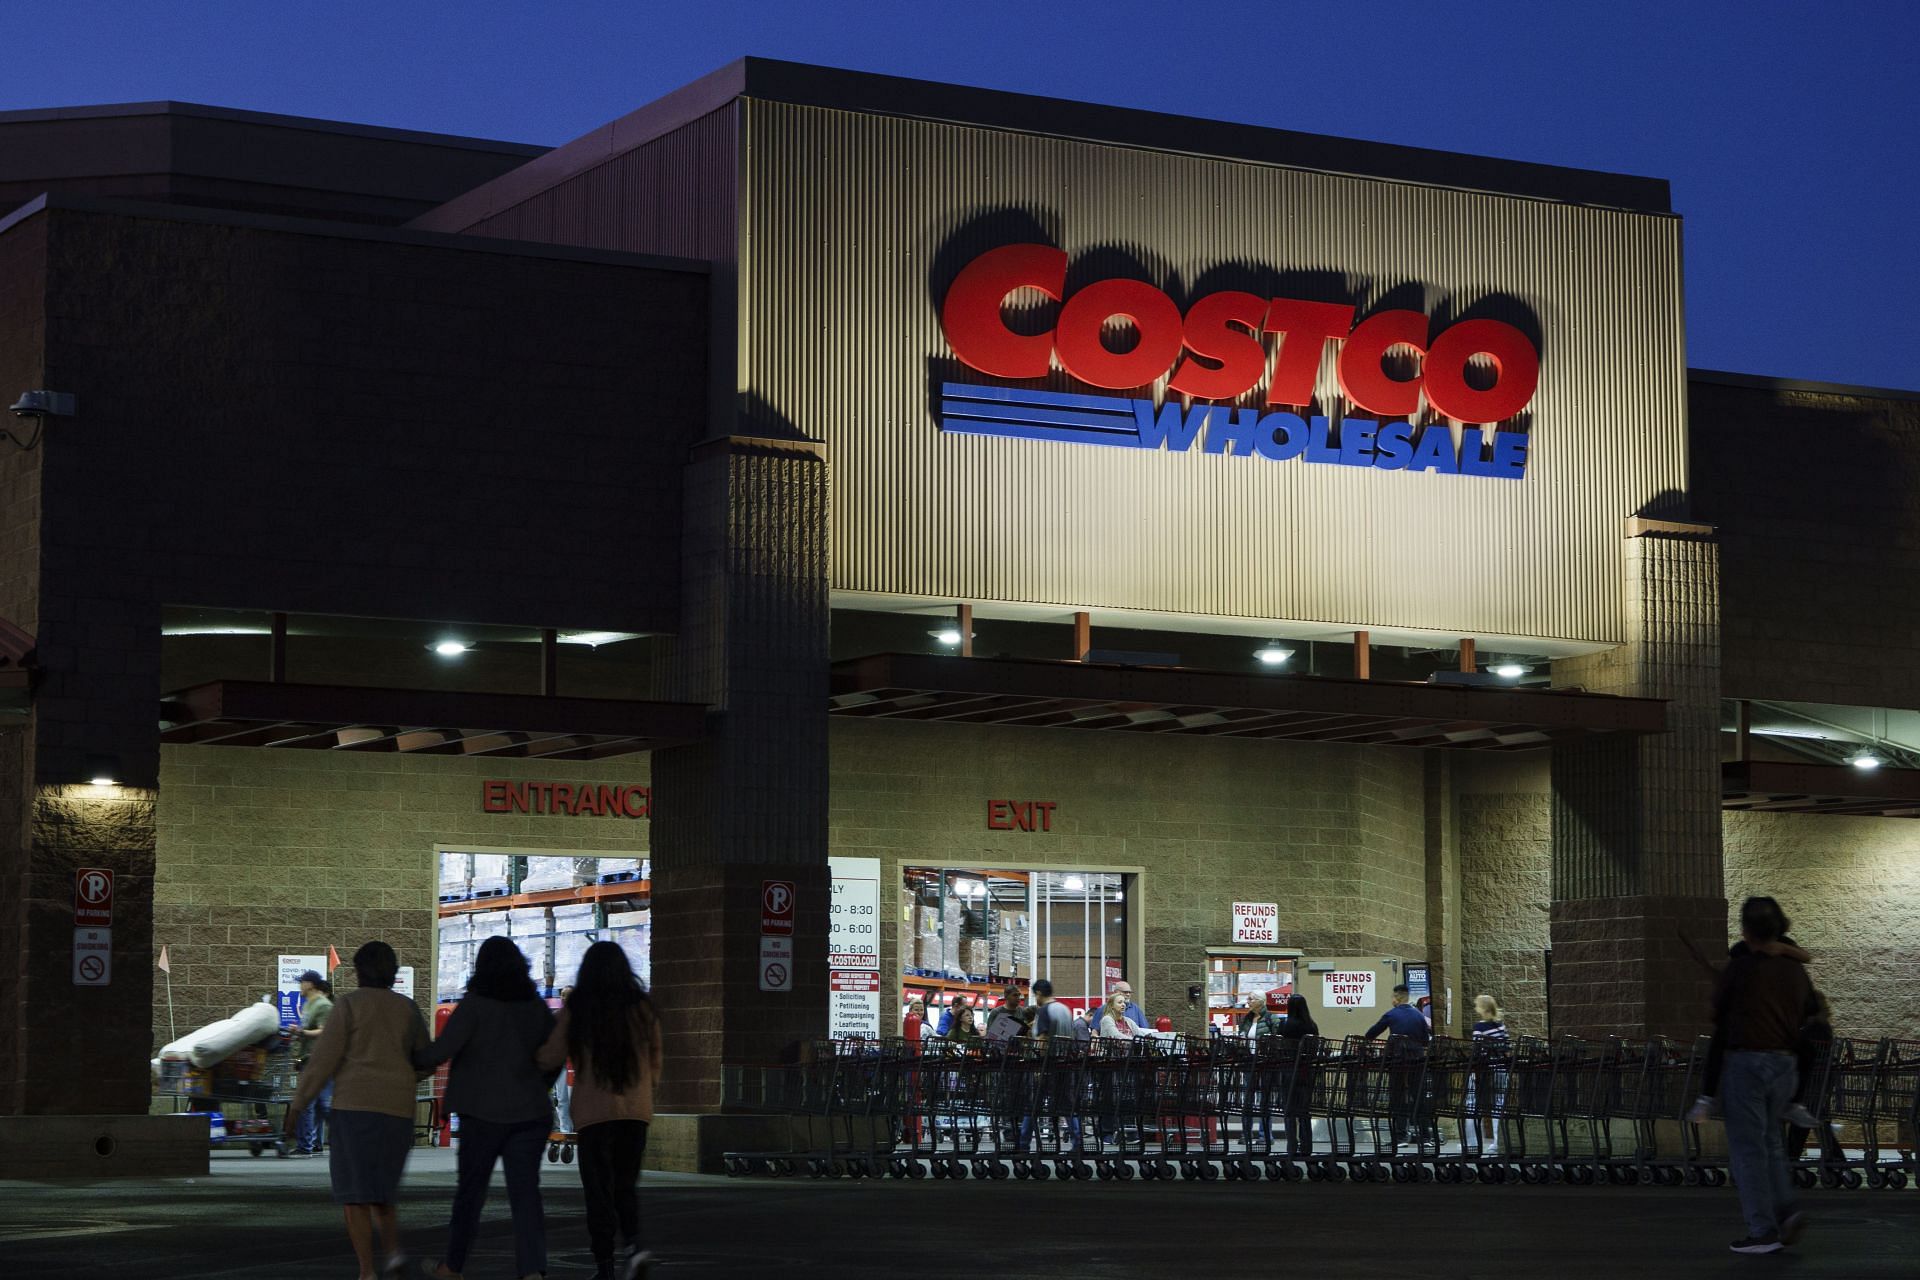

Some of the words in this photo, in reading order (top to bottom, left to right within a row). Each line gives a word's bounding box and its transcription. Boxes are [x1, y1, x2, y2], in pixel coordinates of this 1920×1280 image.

[943, 243, 1539, 424] COSTCO
[1133, 400, 1529, 480] WHOLESALE
[988, 800, 1057, 832] EXIT
[830, 884, 844, 894] LY
[850, 905, 873, 915] 8:30
[1235, 905, 1276, 916] REFUNDS
[1244, 917, 1267, 928] ONLY
[849, 924, 872, 934] 6:00
[1239, 929, 1273, 940] PLEASE
[849, 944, 873, 954] 6:00
[1326, 973, 1372, 983] REFUNDS
[1333, 985, 1364, 993] ENTRY
[839, 993, 866, 1001] Soliciting
[1336, 996, 1362, 1005] ONLY
[839, 1021, 869, 1029] Leafletting
[833, 1031, 876, 1040] PROHIBITED
